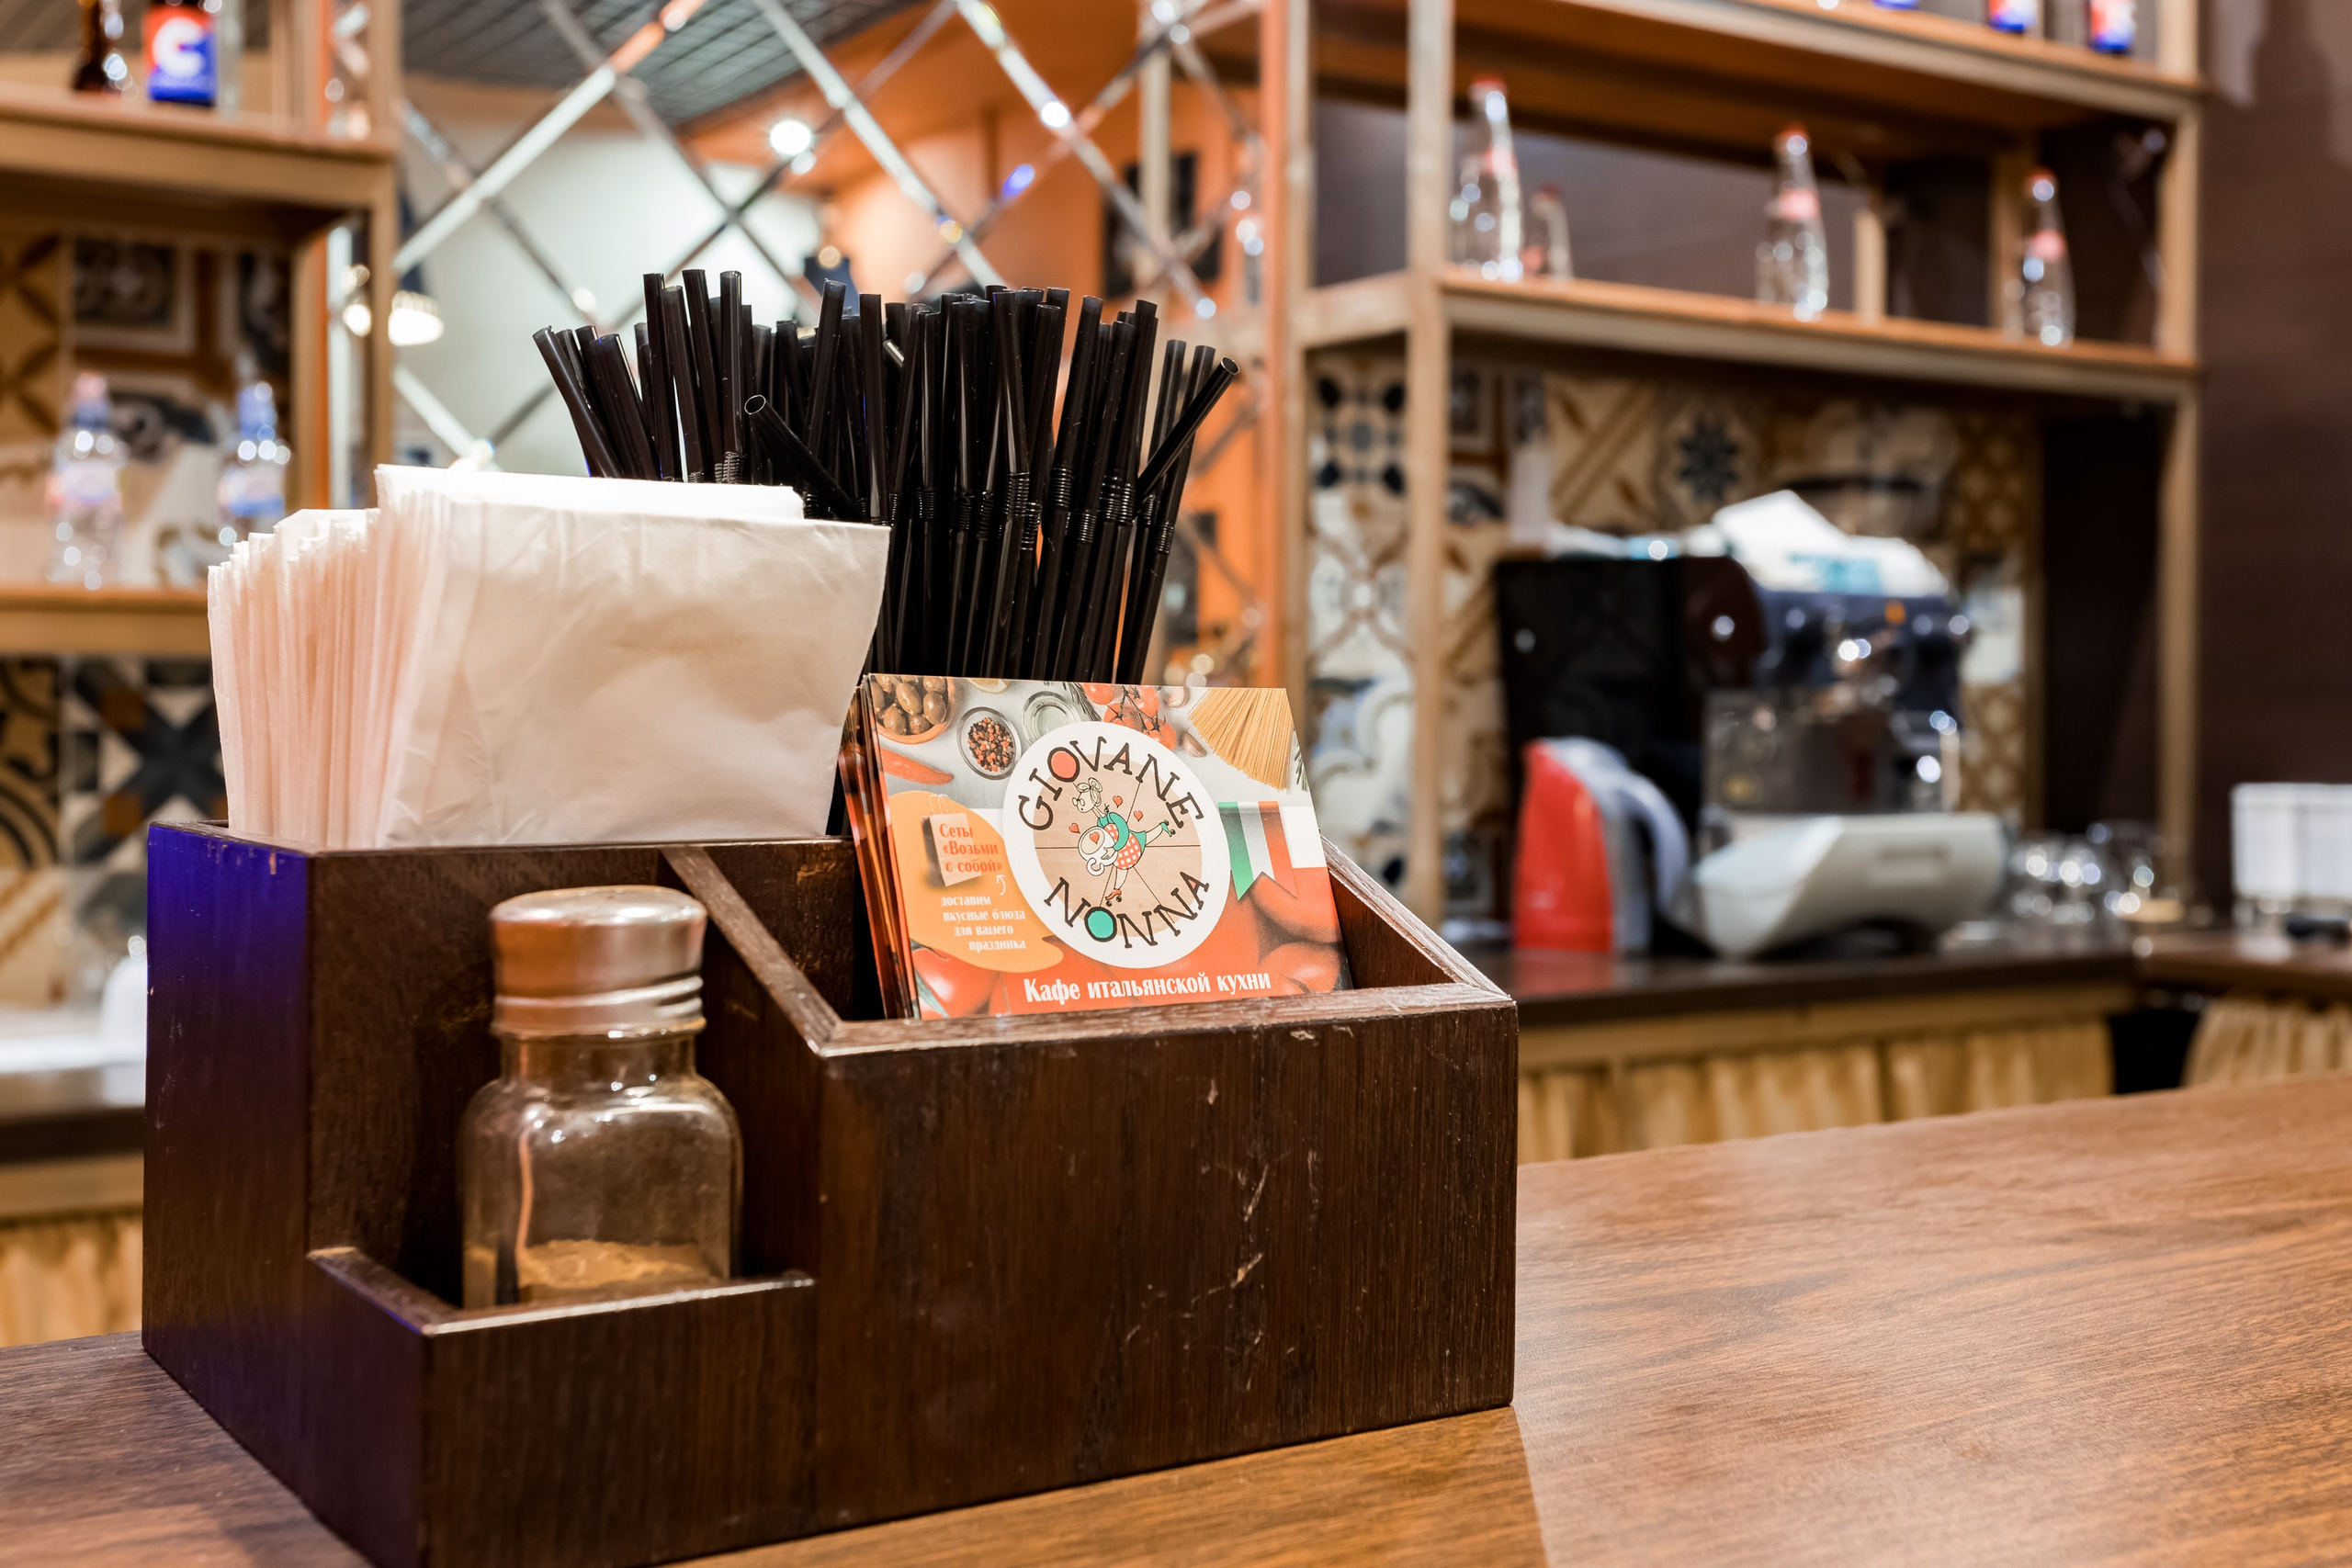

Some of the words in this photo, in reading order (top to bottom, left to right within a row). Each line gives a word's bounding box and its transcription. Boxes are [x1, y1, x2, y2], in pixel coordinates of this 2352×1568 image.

[1018, 736, 1204, 831] GIOVANE
[939, 823, 974, 838] Сеты
[943, 840, 999, 855] «Возьми
[945, 862, 954, 873] с
[957, 858, 1003, 873] собой»
[941, 896, 991, 907] доставим
[943, 910, 989, 924] вкусные
[992, 908, 1026, 920] блюда
[1044, 871, 1210, 949] NONNA
[954, 926, 972, 937] для
[976, 924, 1013, 936] вашего
[968, 939, 1027, 953] праздника
[1023, 978, 1080, 1005] Кафе
[1087, 972, 1211, 999] итальянской
[1216, 973, 1272, 996] кухни
